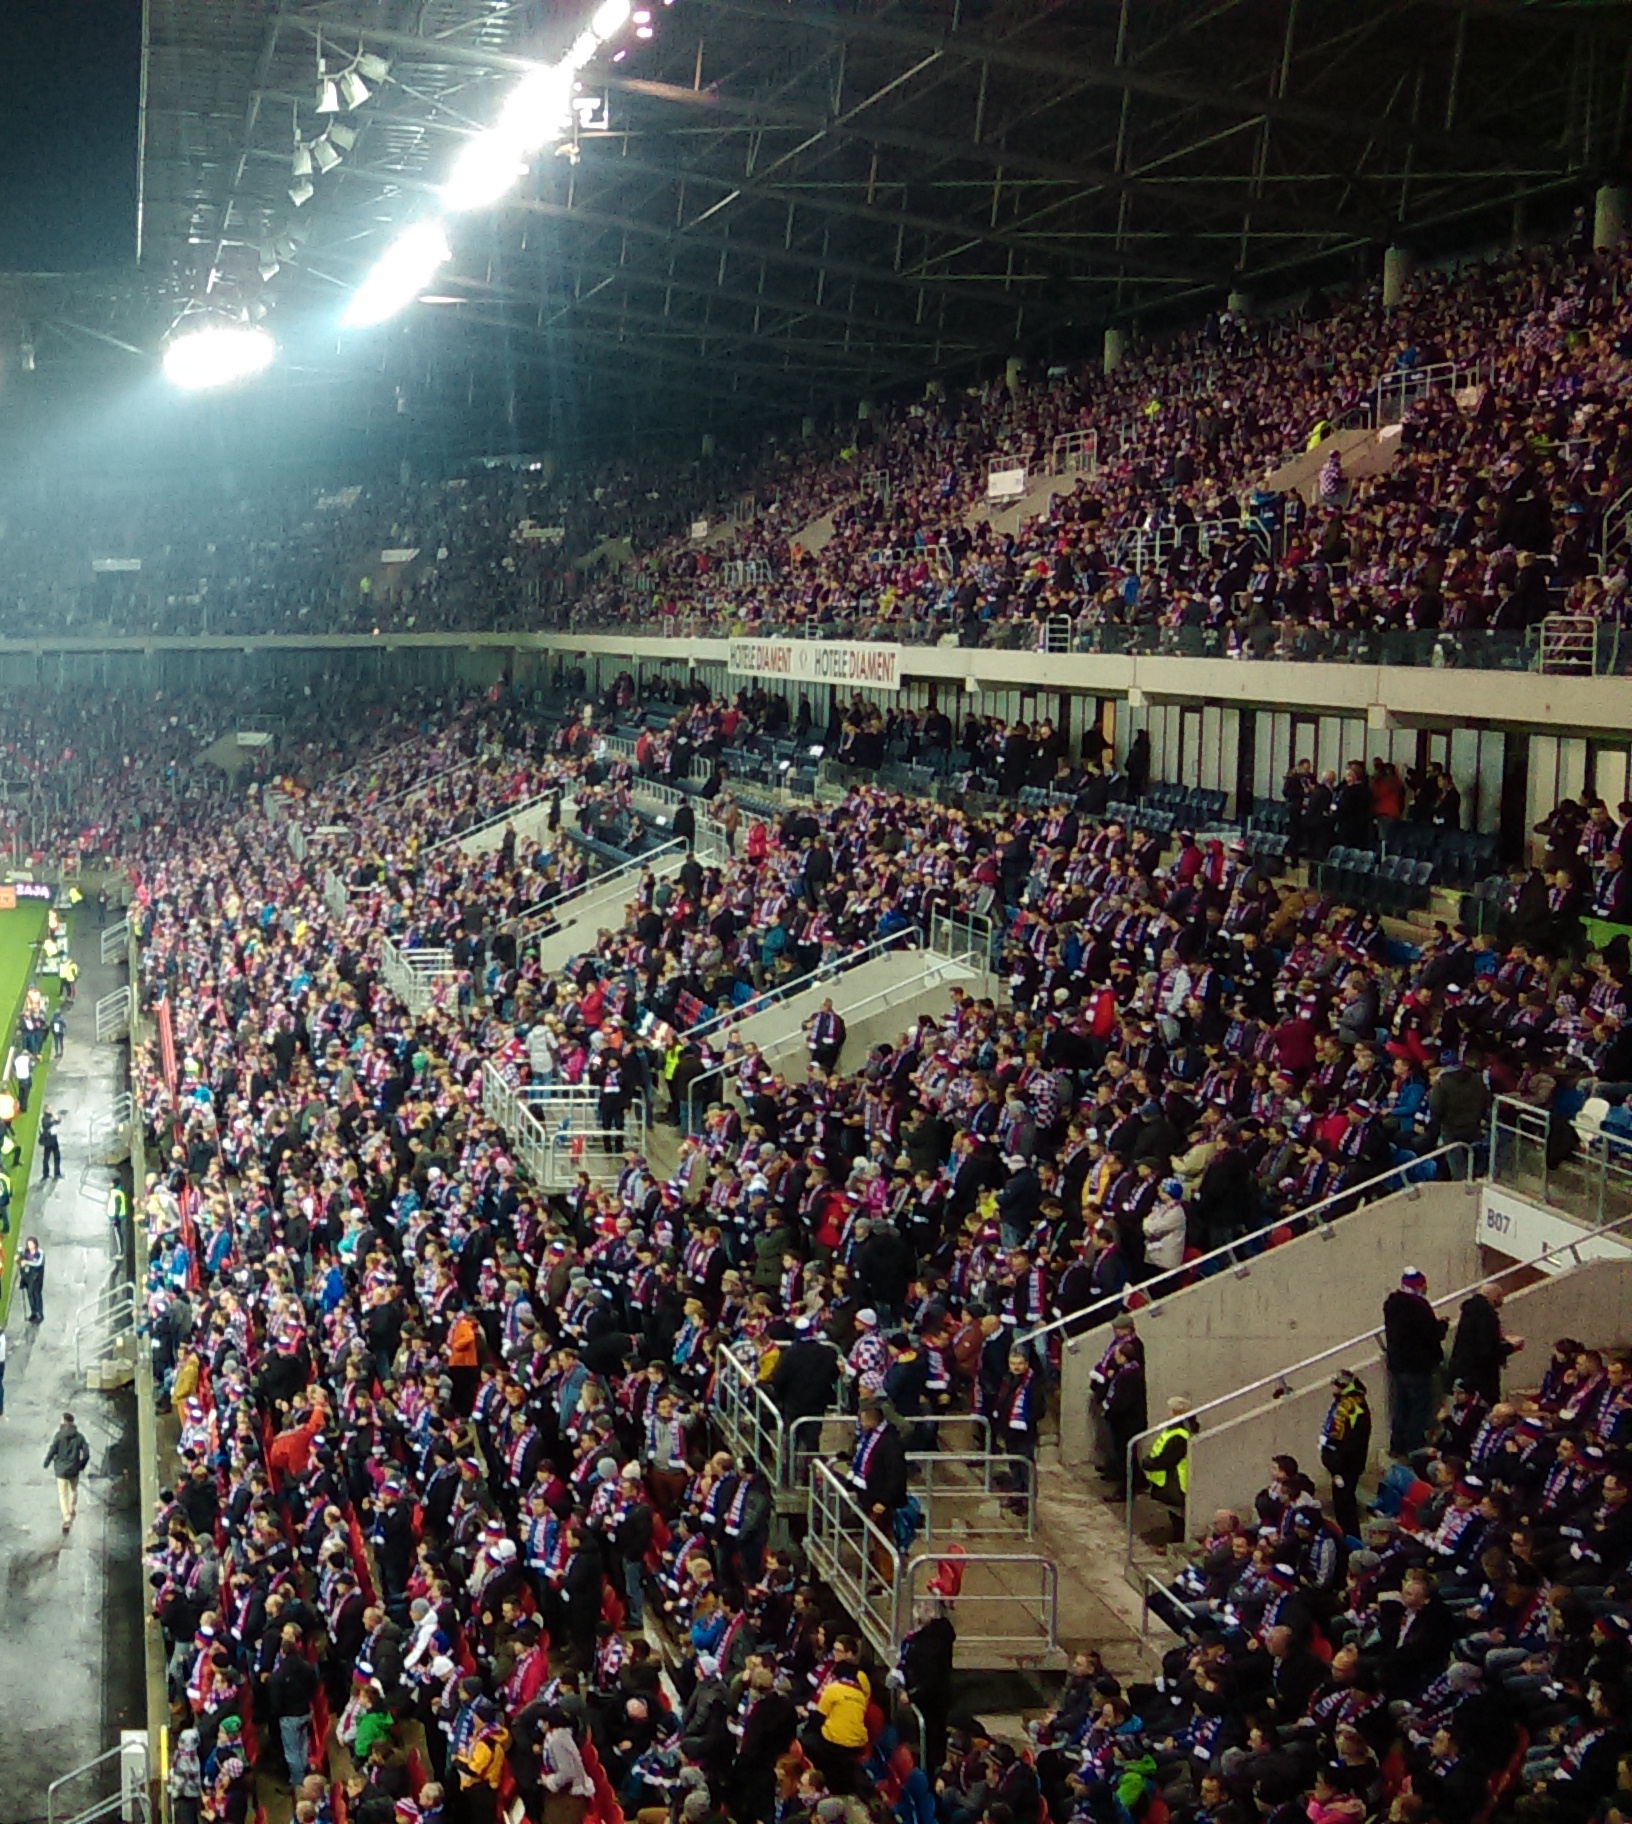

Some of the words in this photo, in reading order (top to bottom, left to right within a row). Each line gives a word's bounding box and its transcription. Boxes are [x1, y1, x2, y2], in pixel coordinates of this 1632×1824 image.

[730, 644, 756, 671] HOTELE
[757, 646, 793, 674] DIAMENT
[814, 648, 848, 679] HOTELE
[849, 650, 896, 683] DIAMENT
[1486, 1208, 1511, 1234] B07
